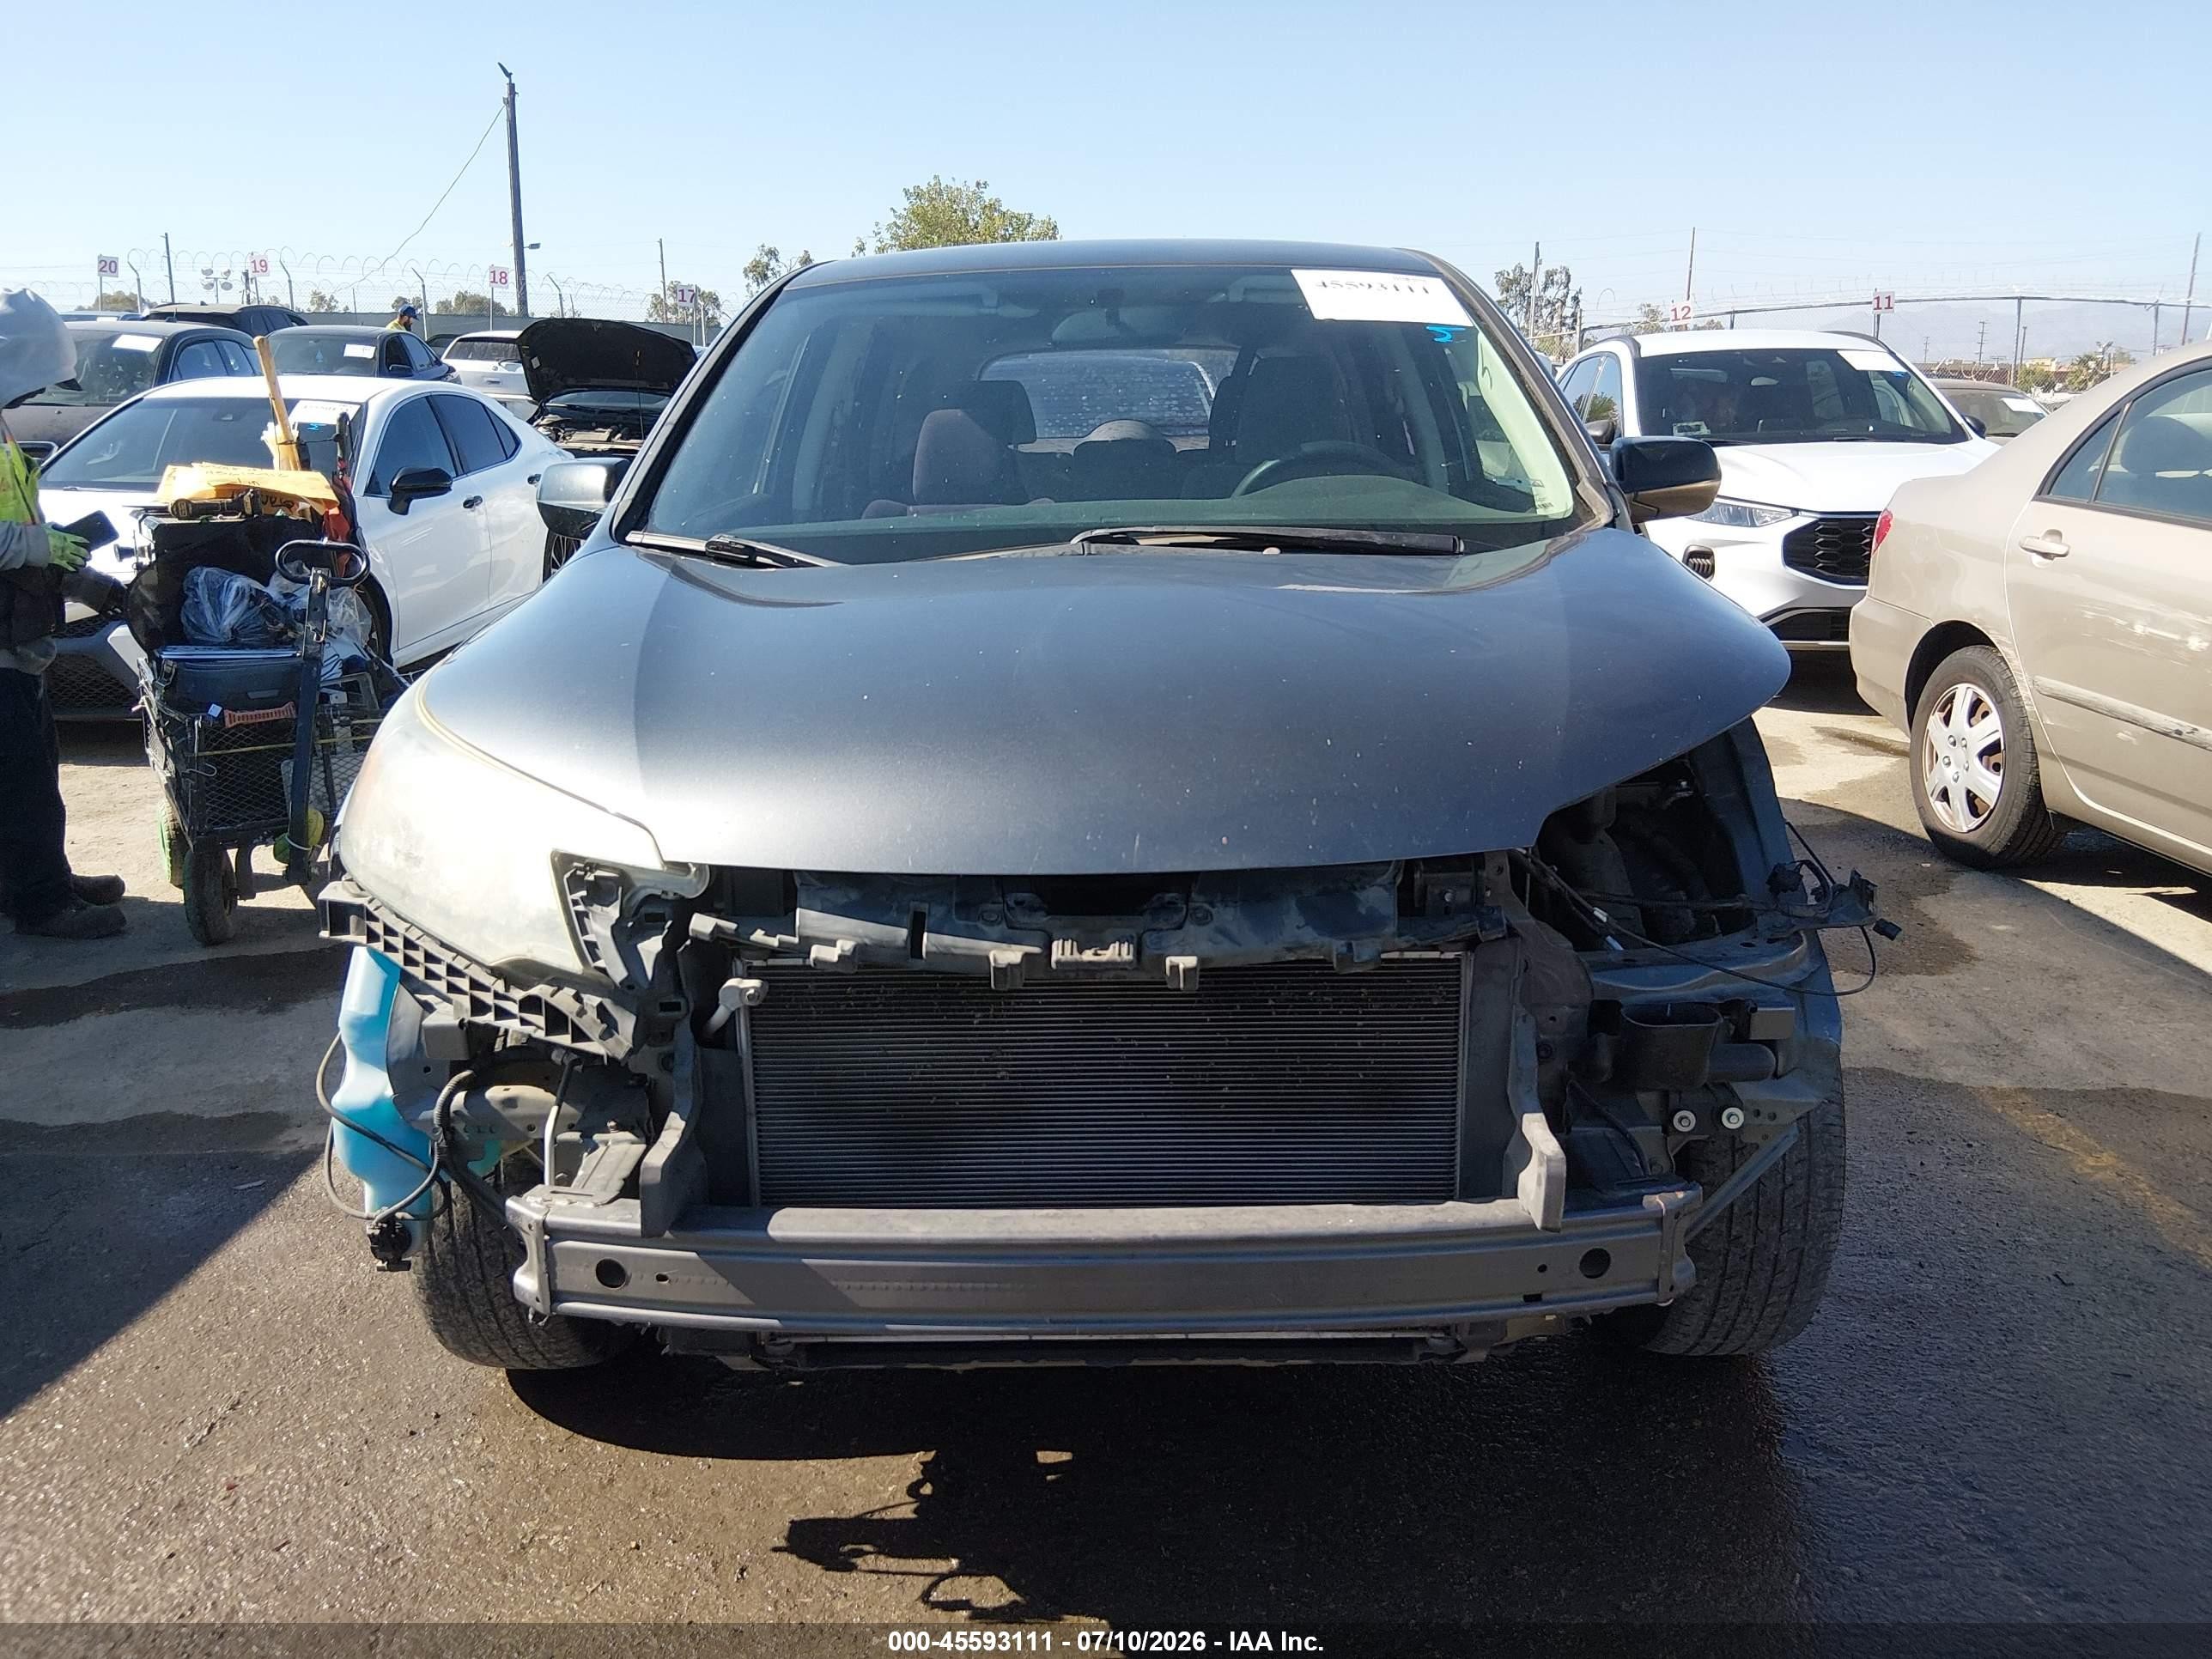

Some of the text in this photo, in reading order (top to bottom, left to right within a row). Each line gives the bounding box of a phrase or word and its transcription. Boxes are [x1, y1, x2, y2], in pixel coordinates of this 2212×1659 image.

[99, 259, 118, 274] 20
[251, 259, 268, 273] 19
[490, 270, 508, 284] 18
[1316, 279, 1431, 295] 45593111
[678, 289, 696, 303] 17
[1873, 295, 1893, 310] 11
[1670, 305, 1691, 322] 12
